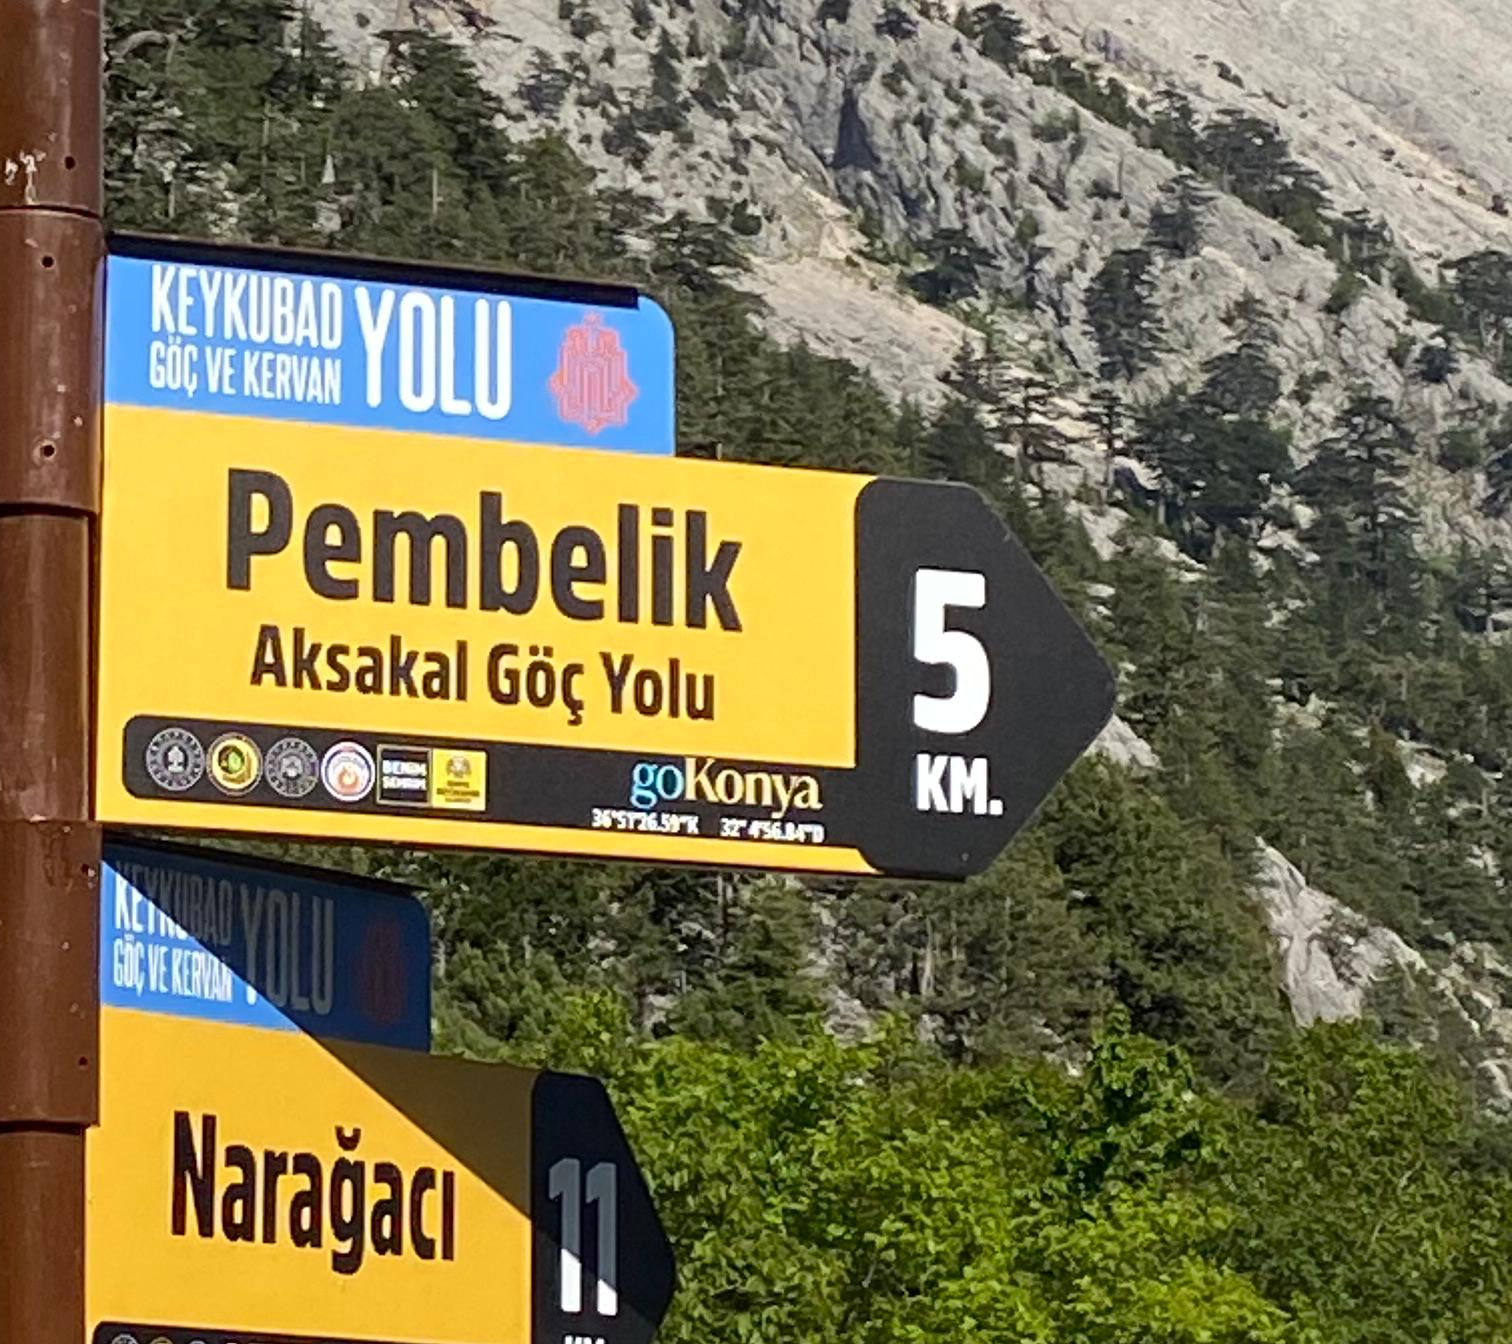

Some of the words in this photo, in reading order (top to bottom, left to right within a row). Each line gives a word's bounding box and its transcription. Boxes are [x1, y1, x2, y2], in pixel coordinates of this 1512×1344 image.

[149, 335, 198, 398] GÖÇ
[205, 348, 236, 396] VE
[244, 351, 341, 405] KERVAN
[150, 263, 342, 350] KEYKUBAD
[354, 286, 512, 420] YOLU
[226, 467, 743, 632] Pembelik
[250, 623, 467, 702] Aksakal
[489, 643, 585, 726] Göç
[600, 651, 716, 721] Yolu
[912, 568, 991, 736] 5
[629, 757, 823, 819] goKonya
[915, 753, 1005, 817] KM.
[113, 933, 146, 997] GÖÇ
[148, 943, 167, 993] VE
[171, 946, 233, 1003] KERVAN
[114, 861, 232, 946] KEYKUBAD
[240, 883, 334, 1016] YOLU
[171, 1110, 455, 1275] Narağacı
[548, 1157, 618, 1317] 11
